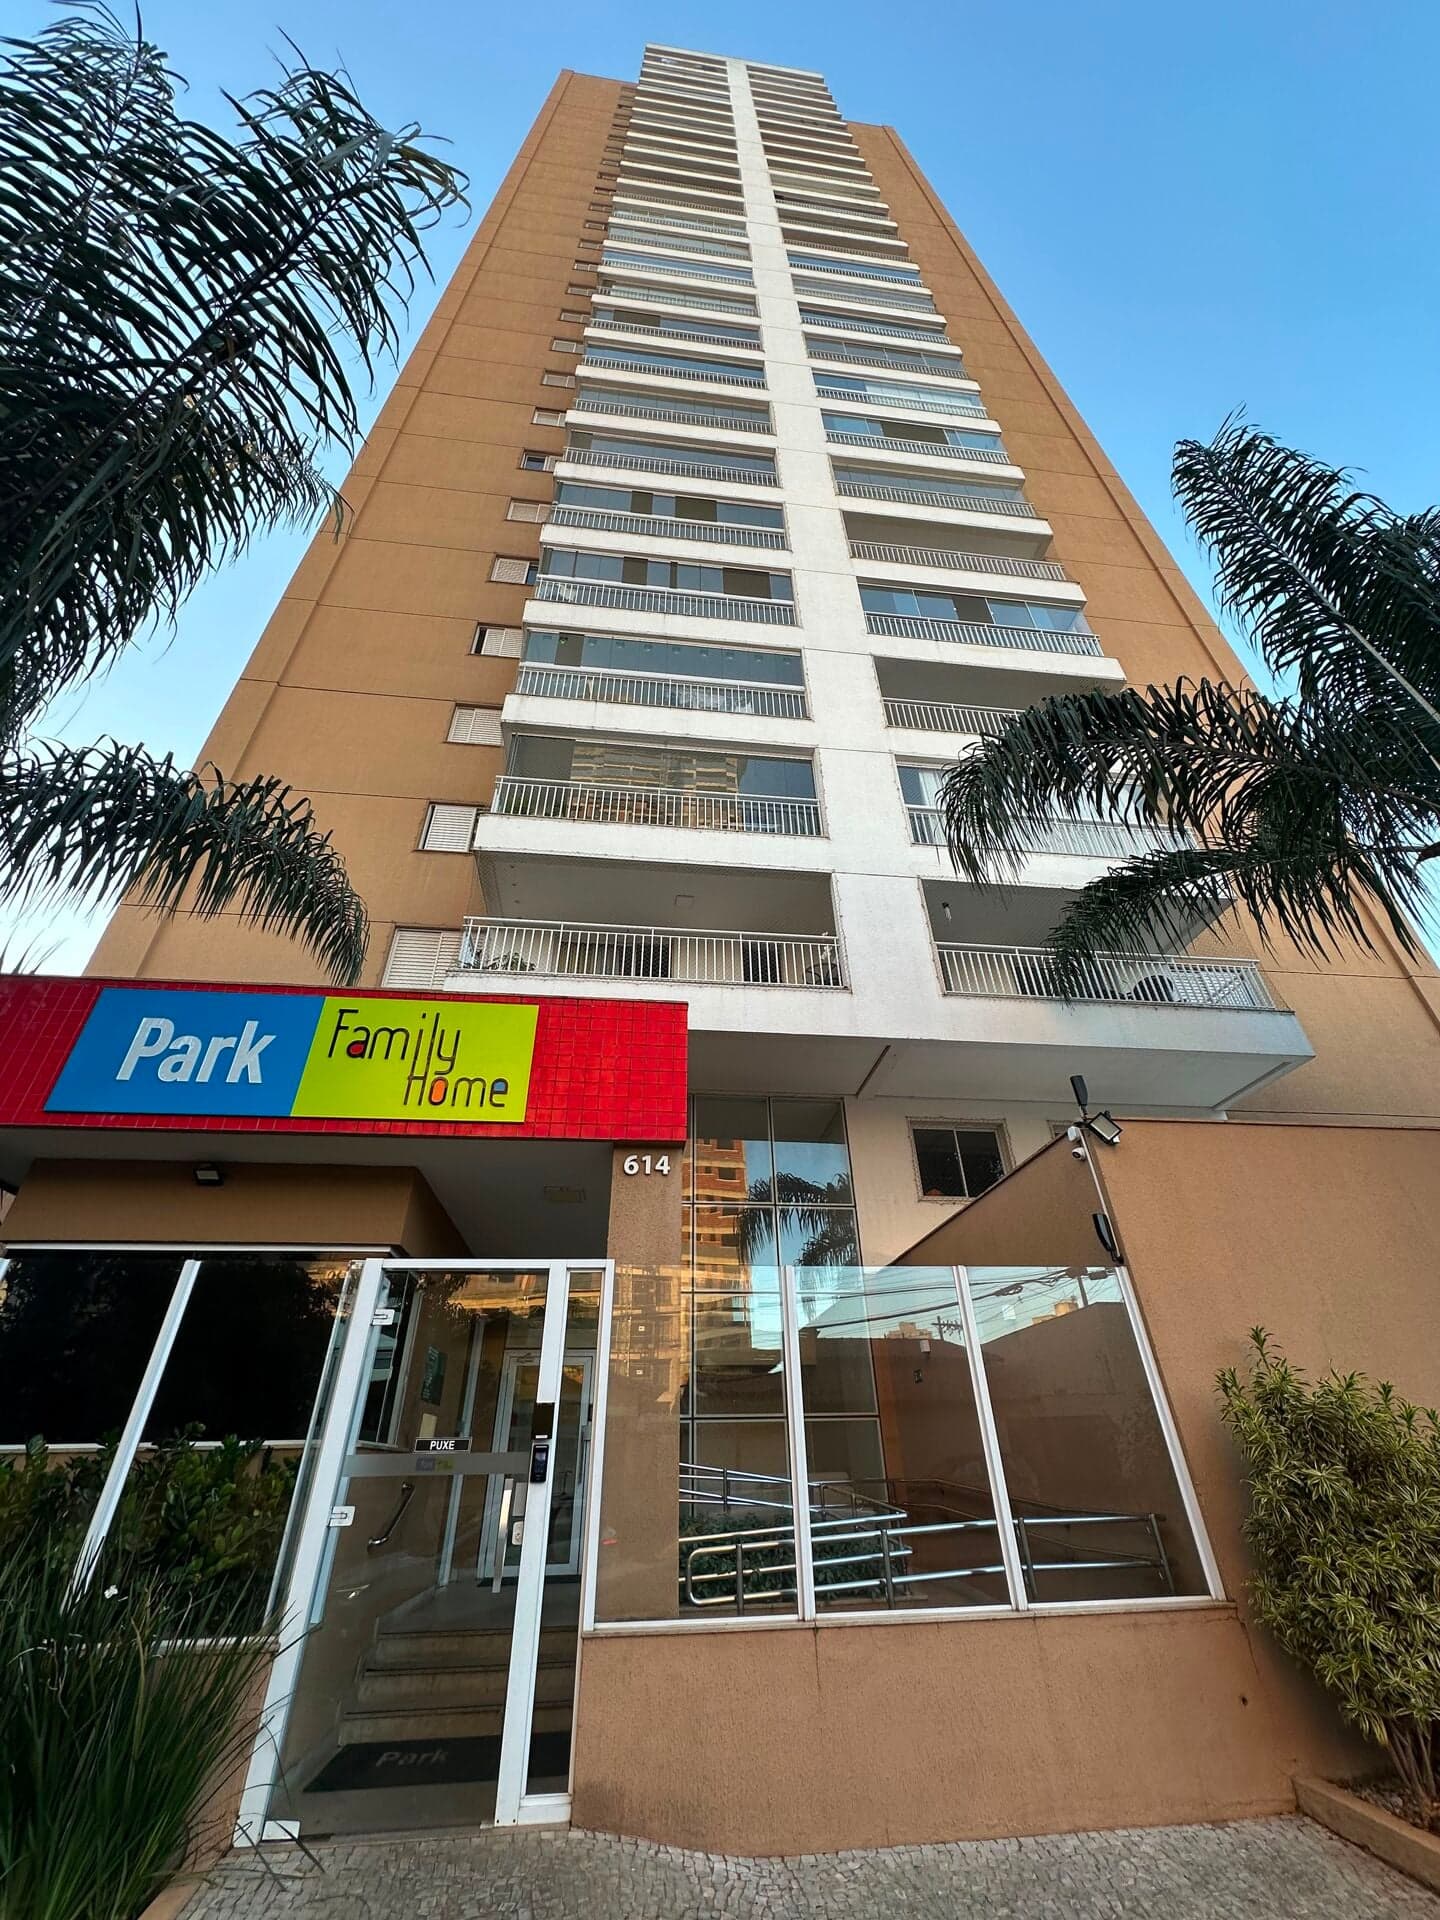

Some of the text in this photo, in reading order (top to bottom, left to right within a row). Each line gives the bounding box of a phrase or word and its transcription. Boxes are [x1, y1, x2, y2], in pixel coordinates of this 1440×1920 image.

[116, 1017, 277, 1083] Park
[328, 1009, 461, 1075] Family
[403, 1071, 508, 1107] Home
[624, 1155, 671, 1175] 614
[429, 1440, 456, 1450] PUXE
[375, 1749, 448, 1767] Park
